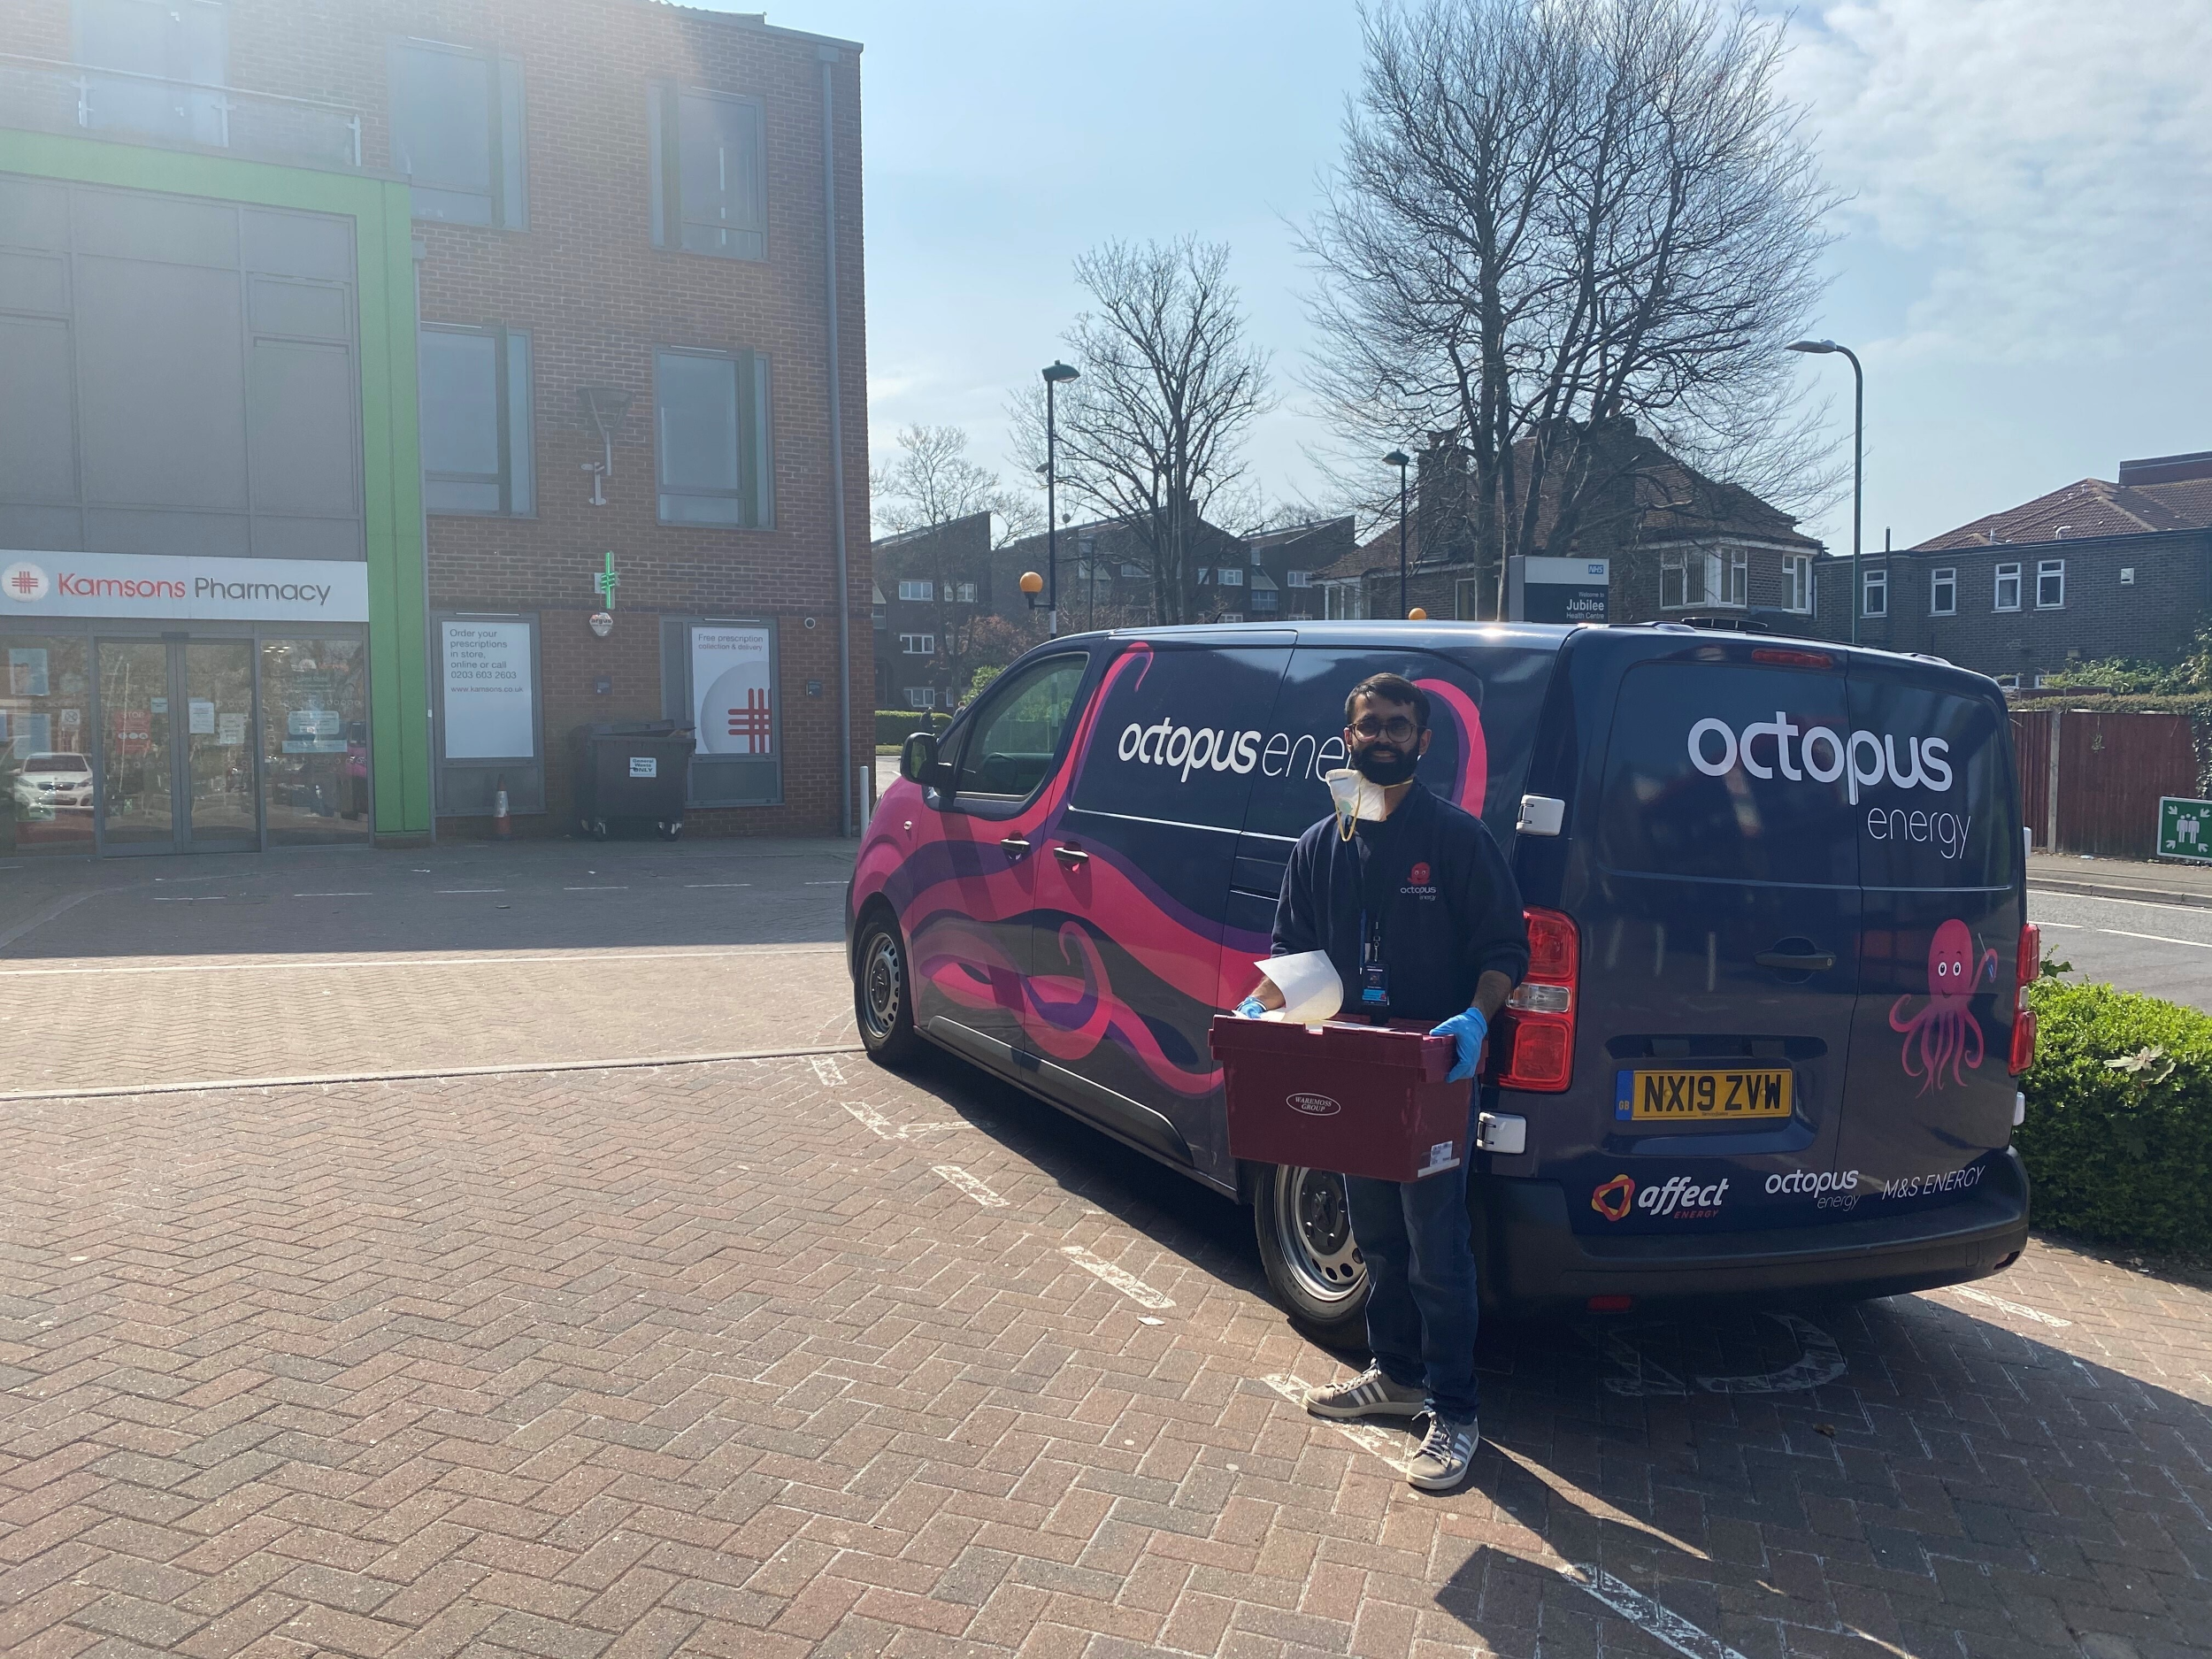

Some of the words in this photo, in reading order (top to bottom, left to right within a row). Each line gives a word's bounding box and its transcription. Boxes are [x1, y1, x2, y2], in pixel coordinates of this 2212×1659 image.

[58, 572, 186, 598] Kamsons
[194, 577, 331, 606] Pharmacy
[1566, 599, 1604, 611] Jubilee
[718, 634, 763, 643] prescription
[1687, 710, 1953, 805] octopus
[1867, 807, 1971, 859] energy
[1400, 886, 1437, 895] octopus
[1294, 1096, 1333, 1107] WAREMOSS
[1644, 1075, 1717, 1112] NX19
[1724, 1074, 1782, 1110] ZVW
[1301, 1103, 1325, 1112] GROUP
[1618, 1100, 1630, 1110] GB
[1765, 1169, 1859, 1199] octopus
[1881, 1177, 1921, 1201] M&S
[1923, 1165, 1985, 1195] ENERGY
[1638, 1176, 1730, 1216] affect
[1816, 1194, 1862, 1212] energy
[1673, 1210, 1719, 1219] ENERGY
